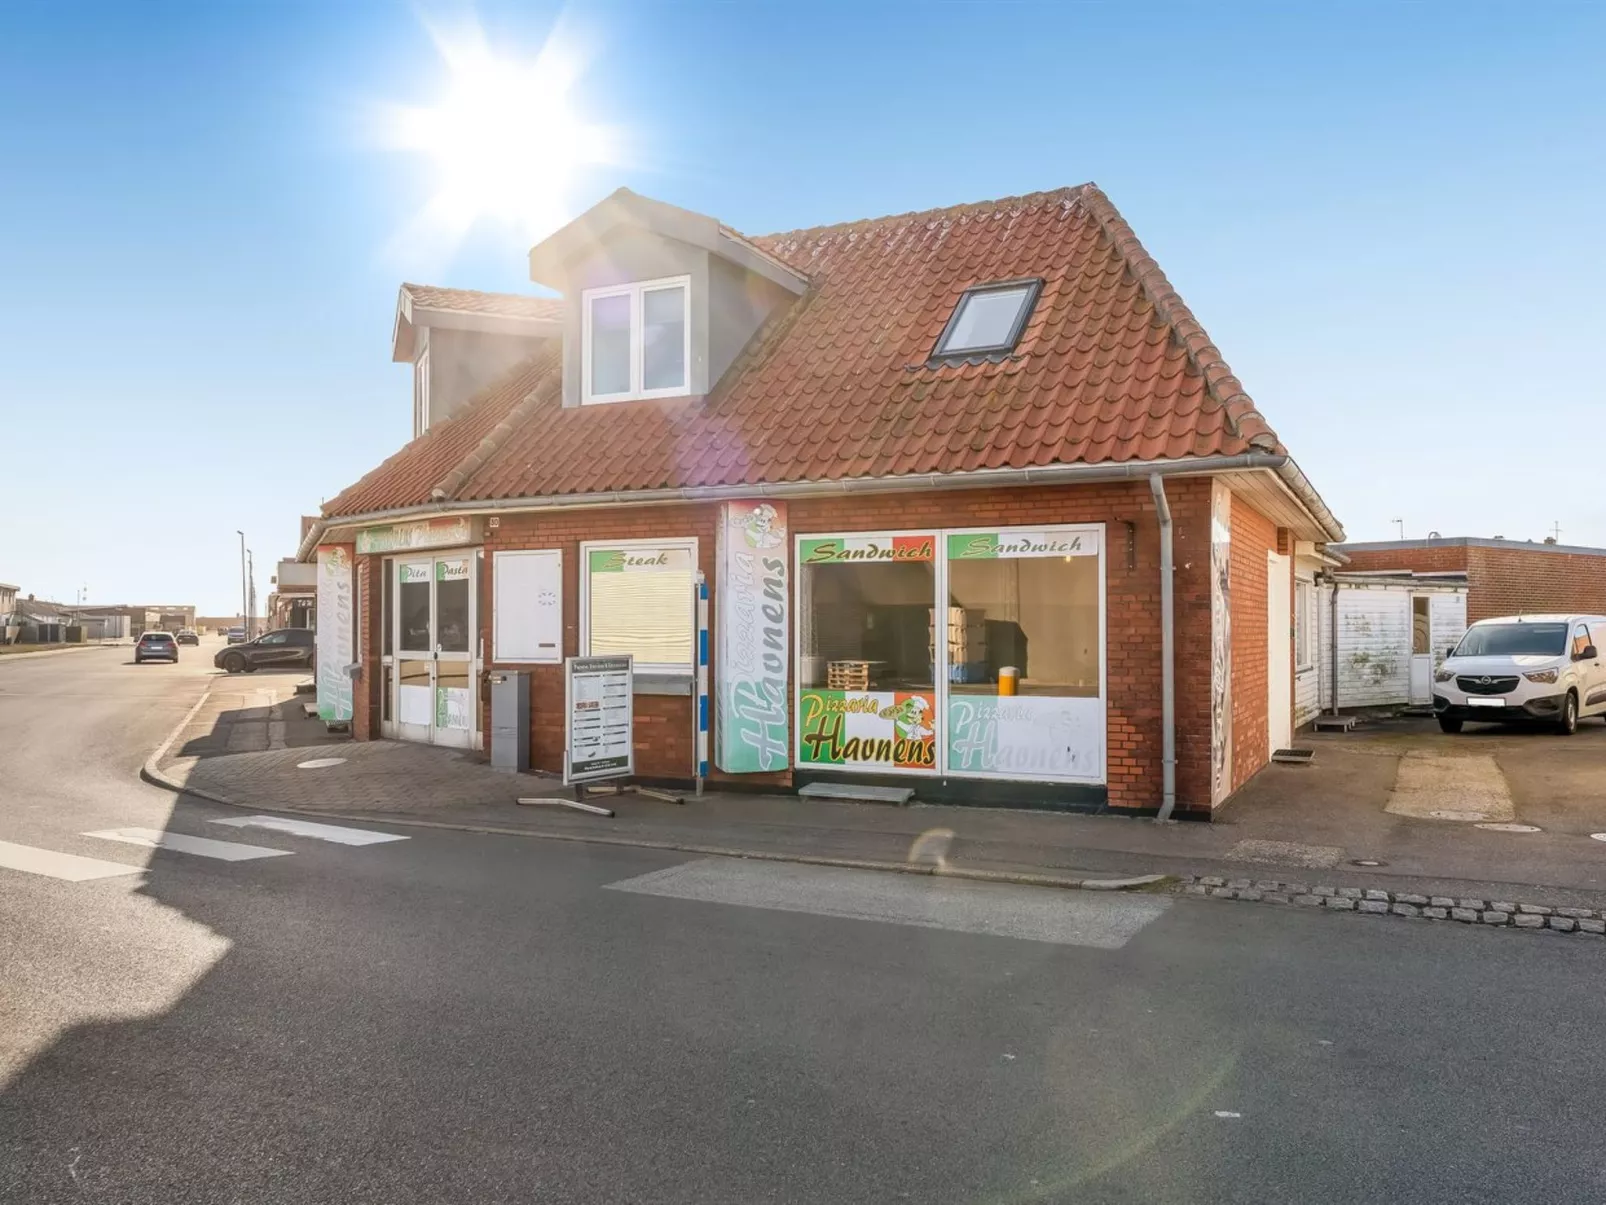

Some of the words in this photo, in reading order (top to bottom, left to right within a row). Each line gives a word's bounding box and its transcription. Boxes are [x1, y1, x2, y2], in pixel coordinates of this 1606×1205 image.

[603, 552, 668, 568] Steak
[805, 540, 932, 563] Sandwich
[960, 536, 1082, 556] Sandwich
[440, 561, 468, 577] Pasta
[730, 551, 767, 718] Pizzaria
[740, 556, 785, 771] Havnens
[800, 694, 880, 728] Pizzaria
[803, 713, 936, 766] Havnens
